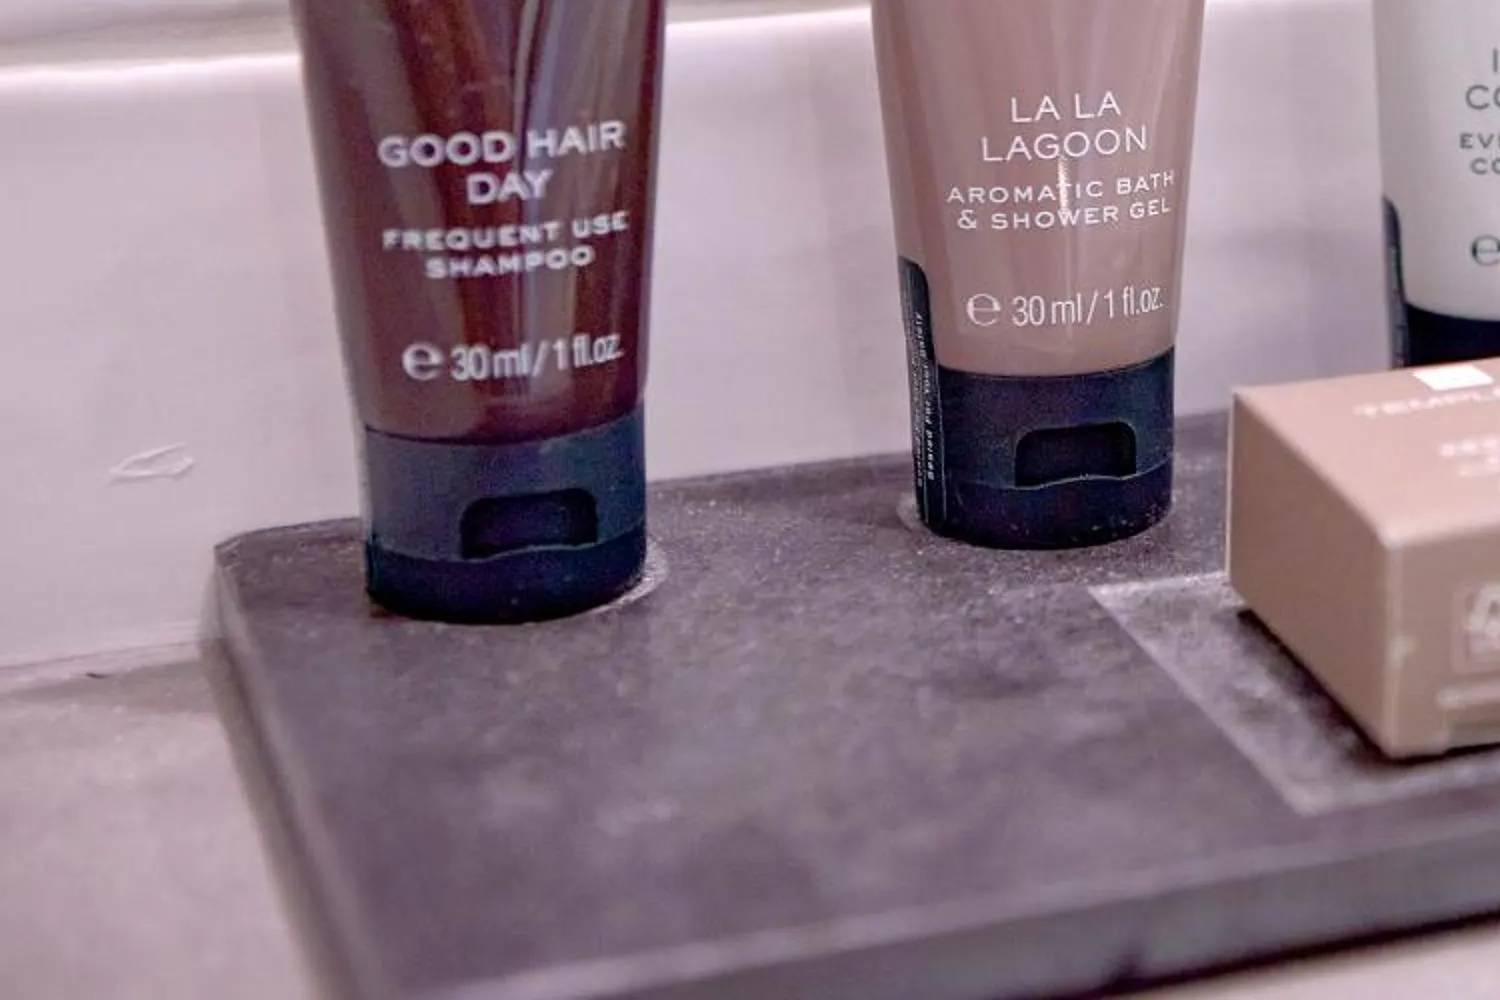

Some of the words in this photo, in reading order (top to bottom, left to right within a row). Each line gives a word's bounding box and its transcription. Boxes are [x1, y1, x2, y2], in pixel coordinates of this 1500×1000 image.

[1010, 95, 1062, 125] LA
[1074, 90, 1122, 120] LA
[377, 130, 517, 168] GOOD
[527, 119, 627, 159] HAIR
[981, 125, 1148, 163] LAGOON
[466, 169, 553, 206] DAY
[947, 180, 1104, 204] AROMATIC
[1116, 169, 1176, 196] BATH
[382, 220, 562, 252] FREQUENT
[571, 210, 630, 239] USE
[957, 209, 978, 231] &
[991, 206, 1120, 231] SHOWER
[1129, 198, 1173, 220] GEL
[425, 244, 597, 280] SHAMPOO
